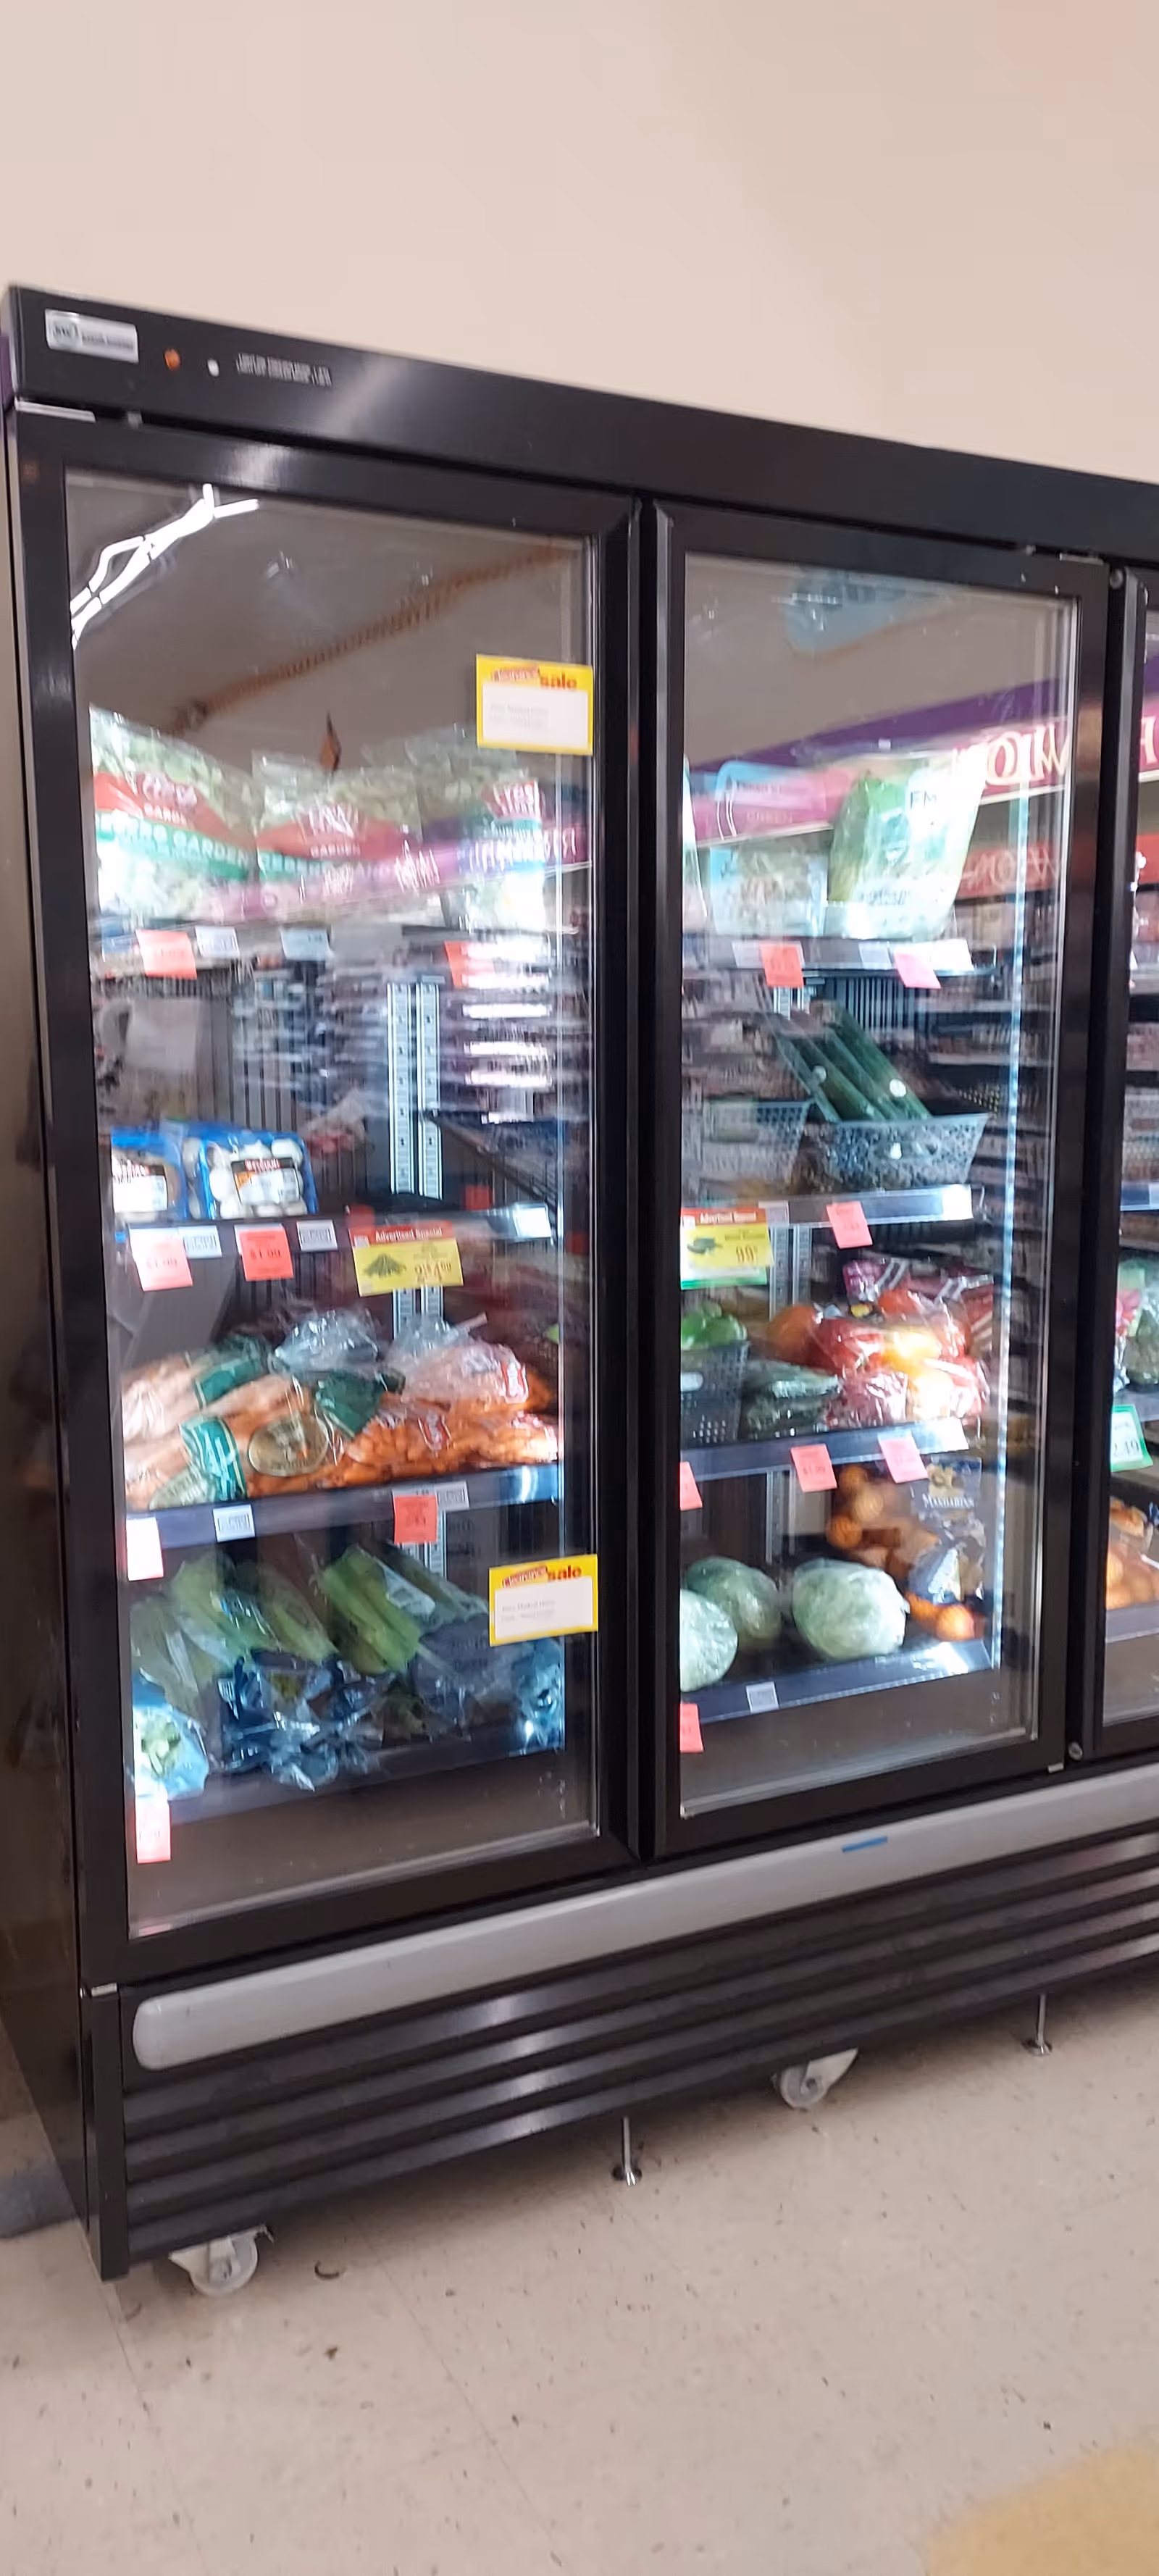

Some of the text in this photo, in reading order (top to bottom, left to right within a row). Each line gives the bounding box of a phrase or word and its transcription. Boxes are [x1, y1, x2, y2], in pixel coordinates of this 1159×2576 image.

[538, 671, 578, 690] sale
[375, 1229, 415, 1243] Advertised
[546, 1564, 582, 1581] sale
